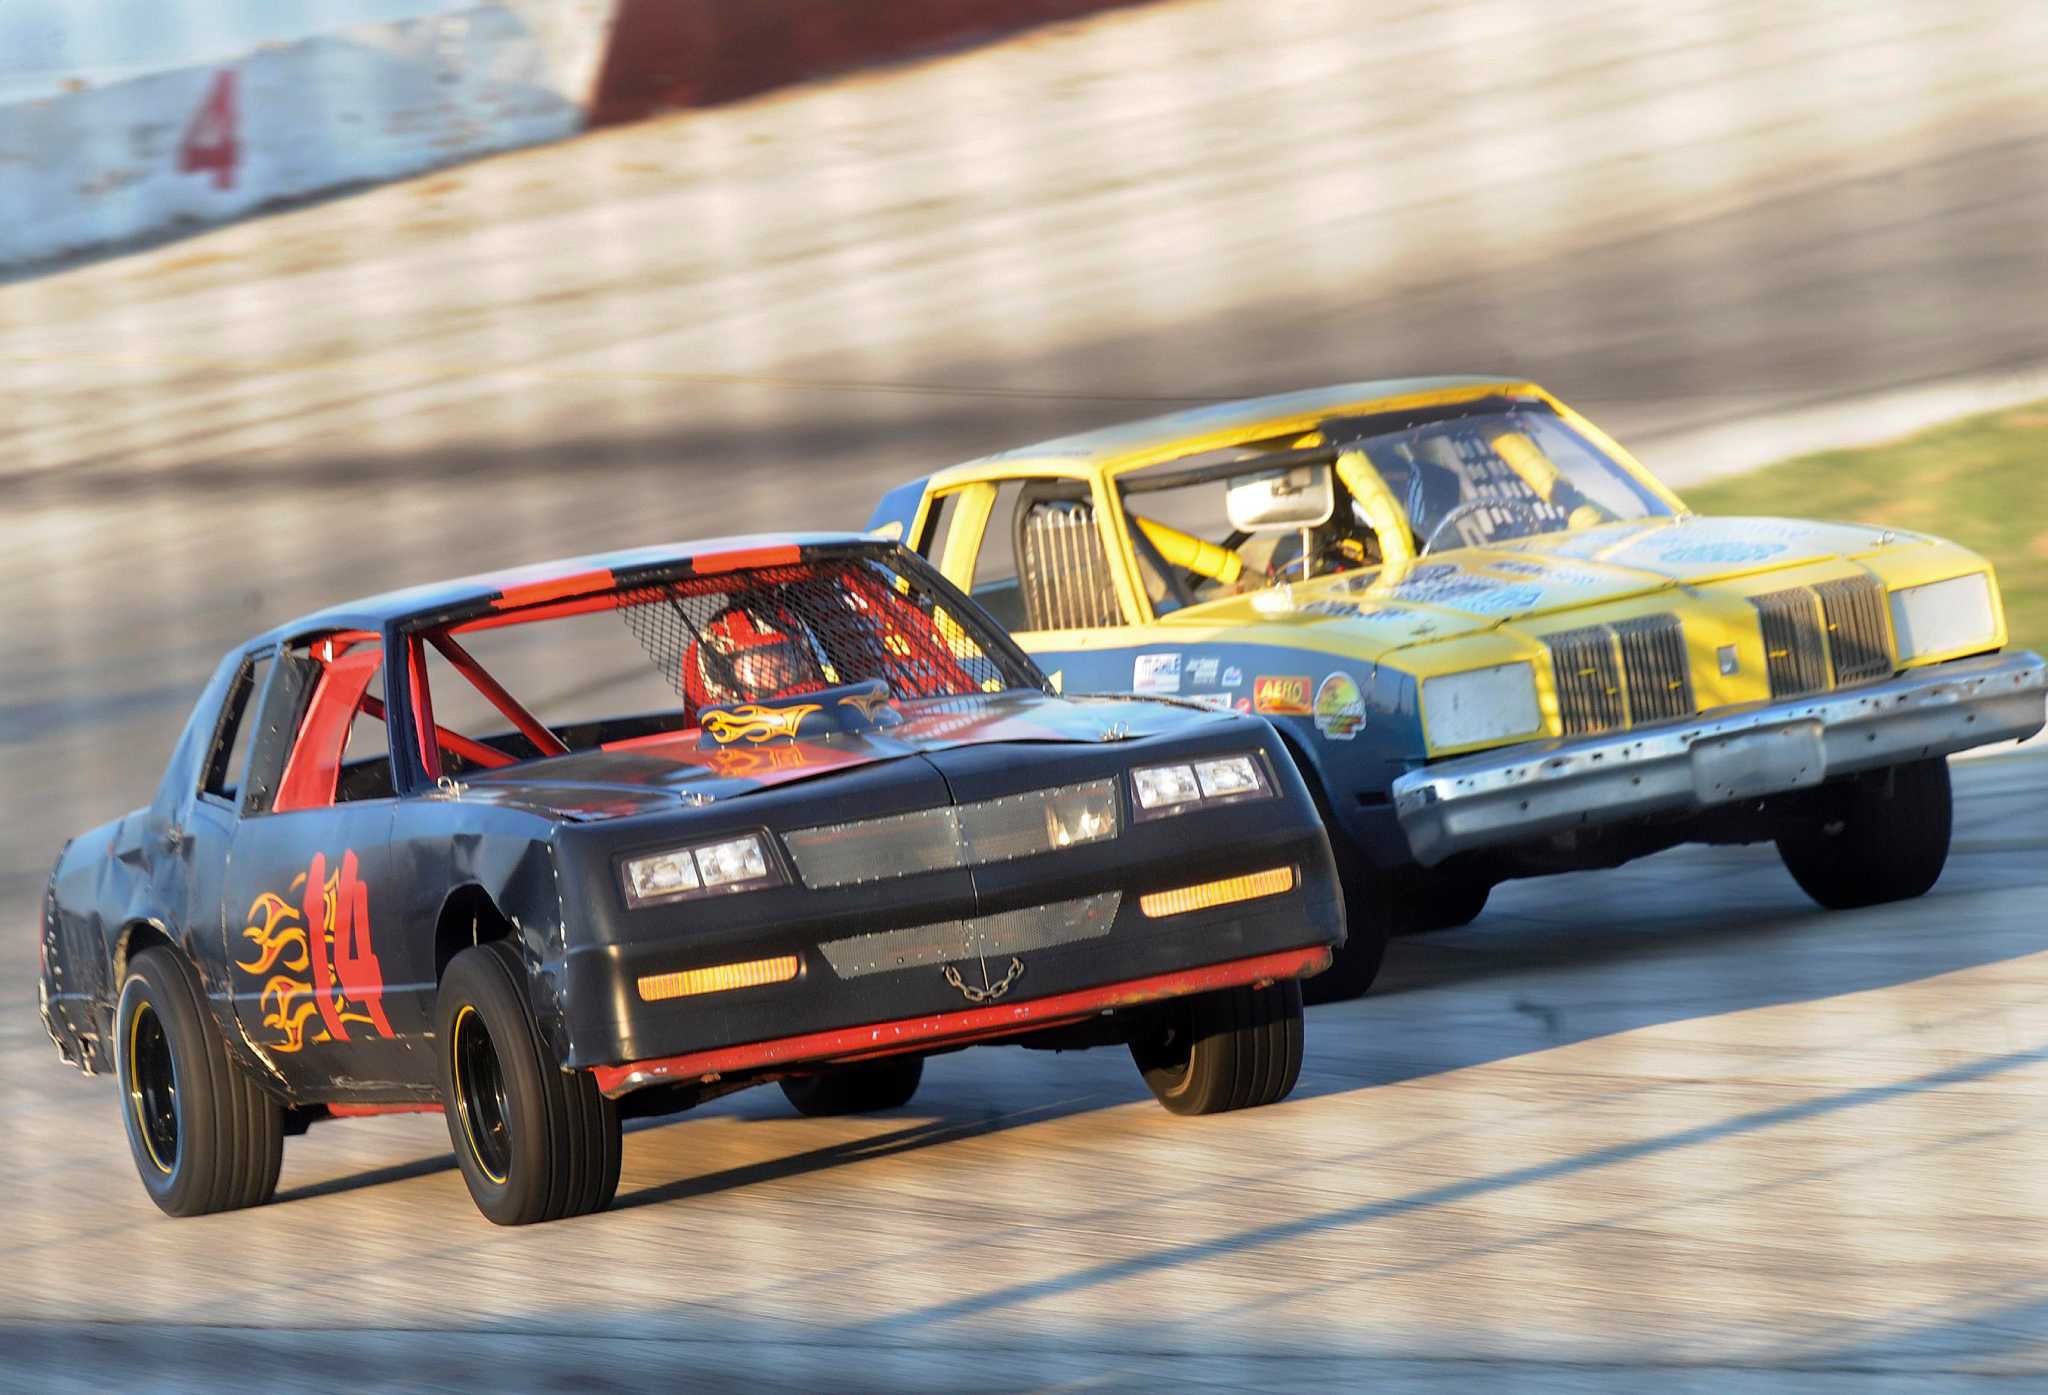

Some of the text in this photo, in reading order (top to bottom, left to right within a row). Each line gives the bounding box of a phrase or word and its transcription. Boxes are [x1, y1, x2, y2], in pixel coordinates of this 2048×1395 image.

[177, 69, 241, 189] 4
[1260, 679, 1303, 702] AERO
[304, 848, 395, 1041] 14
